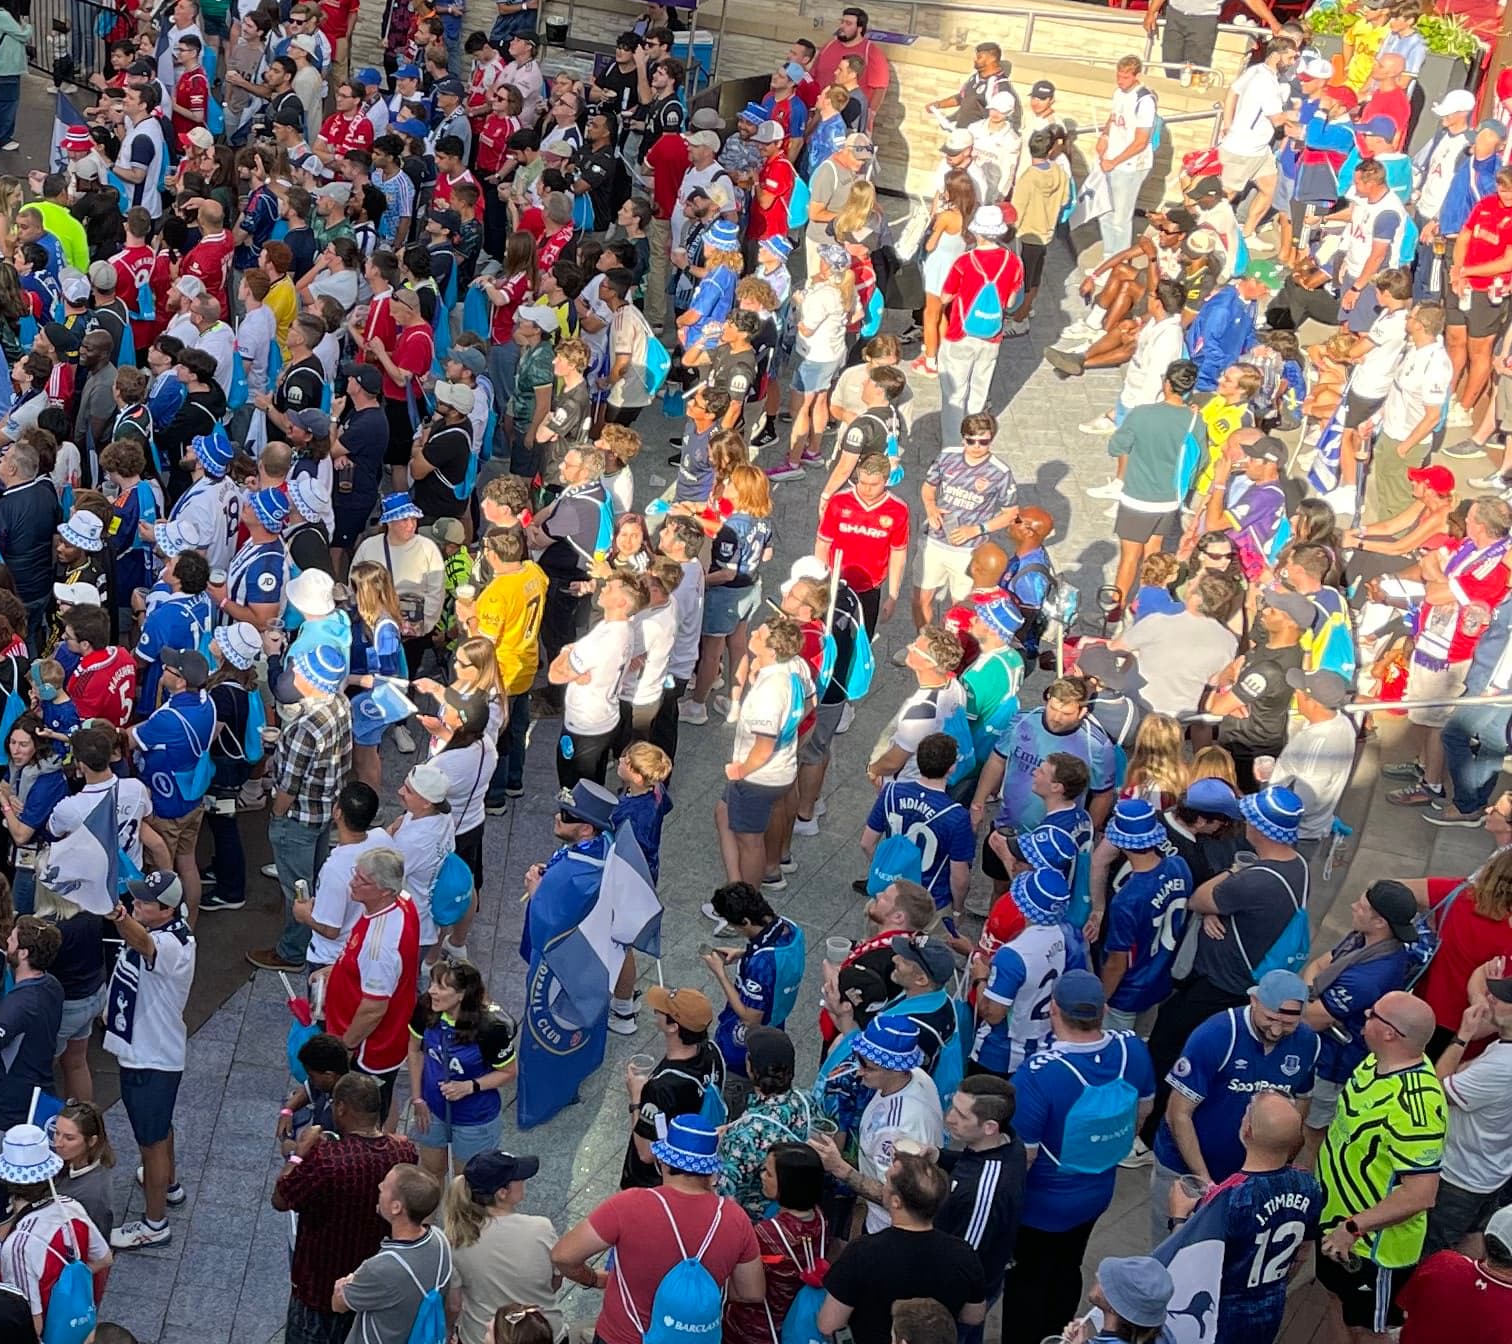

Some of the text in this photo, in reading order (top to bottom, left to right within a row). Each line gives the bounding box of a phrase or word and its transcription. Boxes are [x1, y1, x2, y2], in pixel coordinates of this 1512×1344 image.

[839, 522, 887, 538] SHARP
[108, 665, 136, 695] MAGUIRE
[119, 680, 134, 726] 5
[899, 797, 937, 820] NDIAYE
[1151, 878, 1185, 910] PALMER
[537, 1017, 561, 1046] CLUB
[1247, 1221, 1304, 1288] 12
